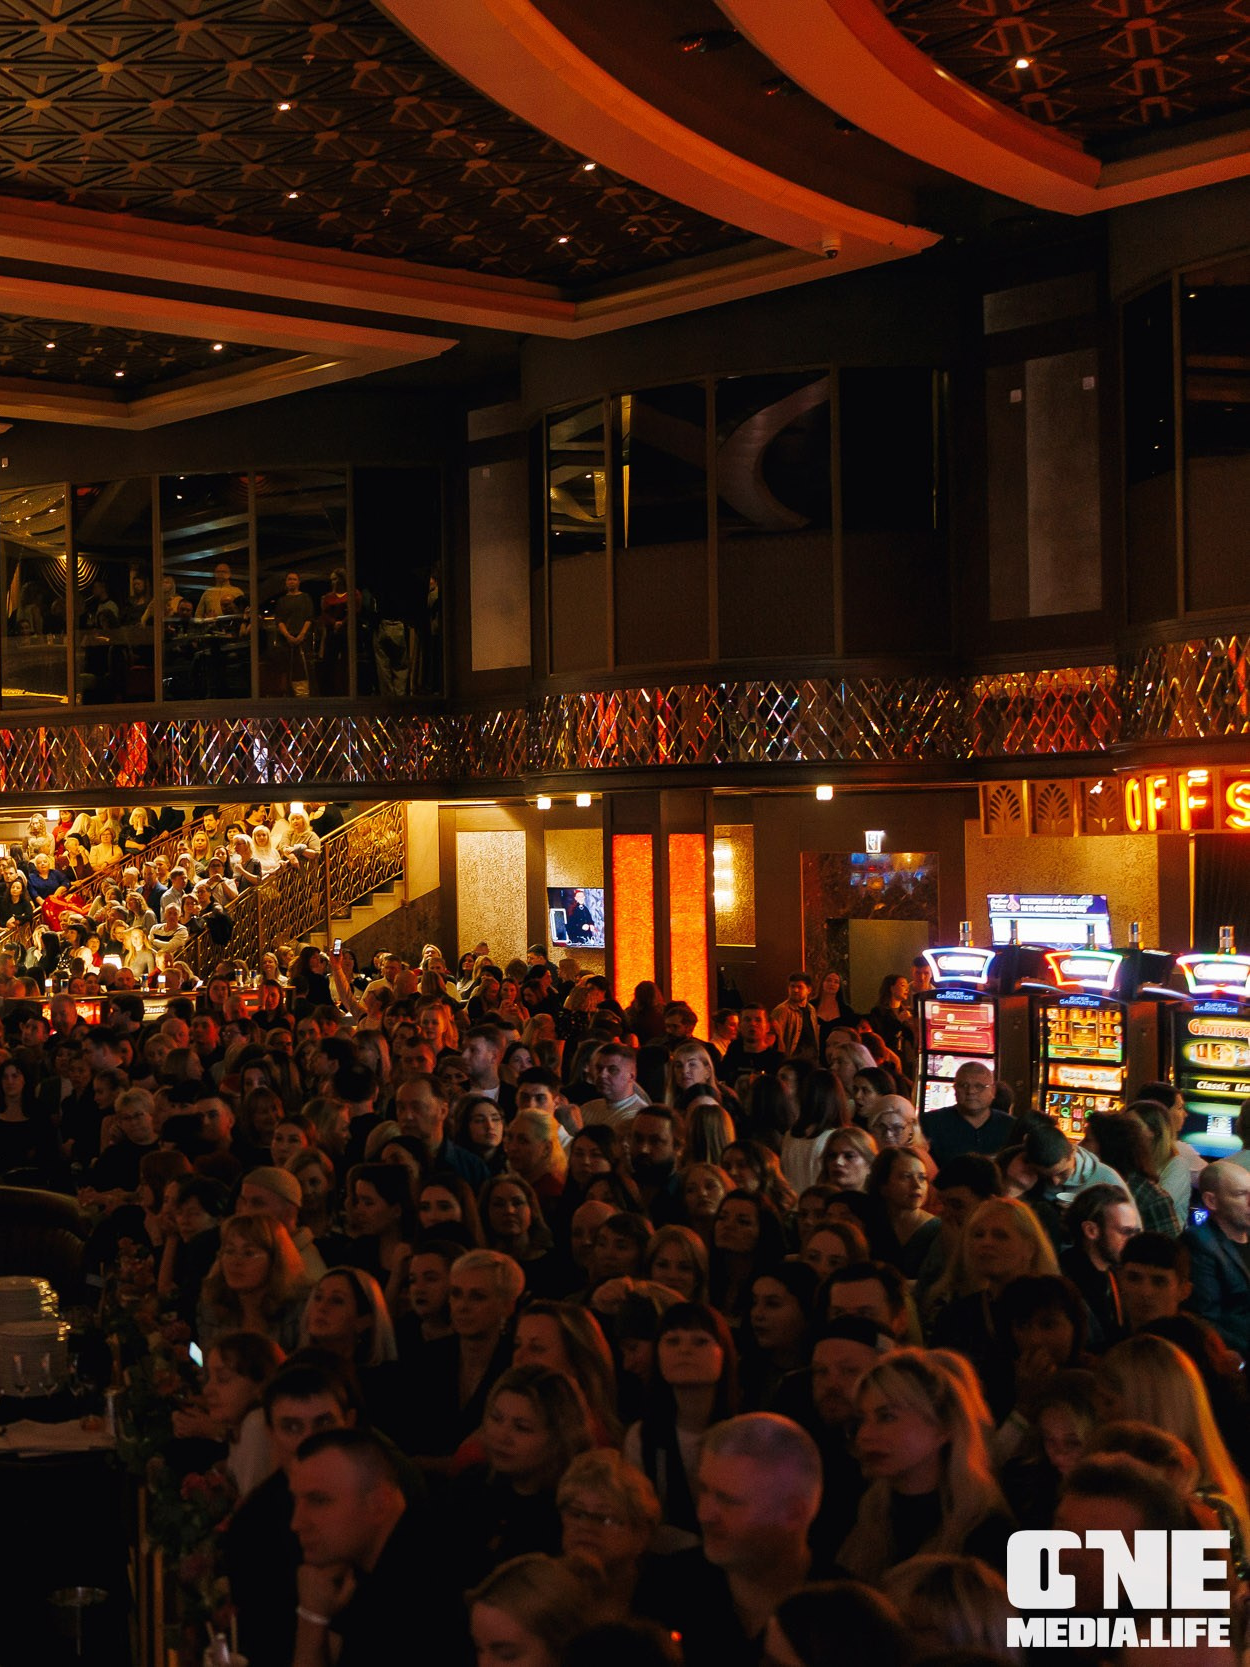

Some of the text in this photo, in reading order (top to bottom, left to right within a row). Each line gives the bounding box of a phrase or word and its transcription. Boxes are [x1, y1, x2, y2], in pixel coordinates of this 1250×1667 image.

[1125, 773, 1209, 831] OFF
[1193, 1005, 1238, 1013] GAMINATOR
[1196, 1080, 1230, 1091] Classic
